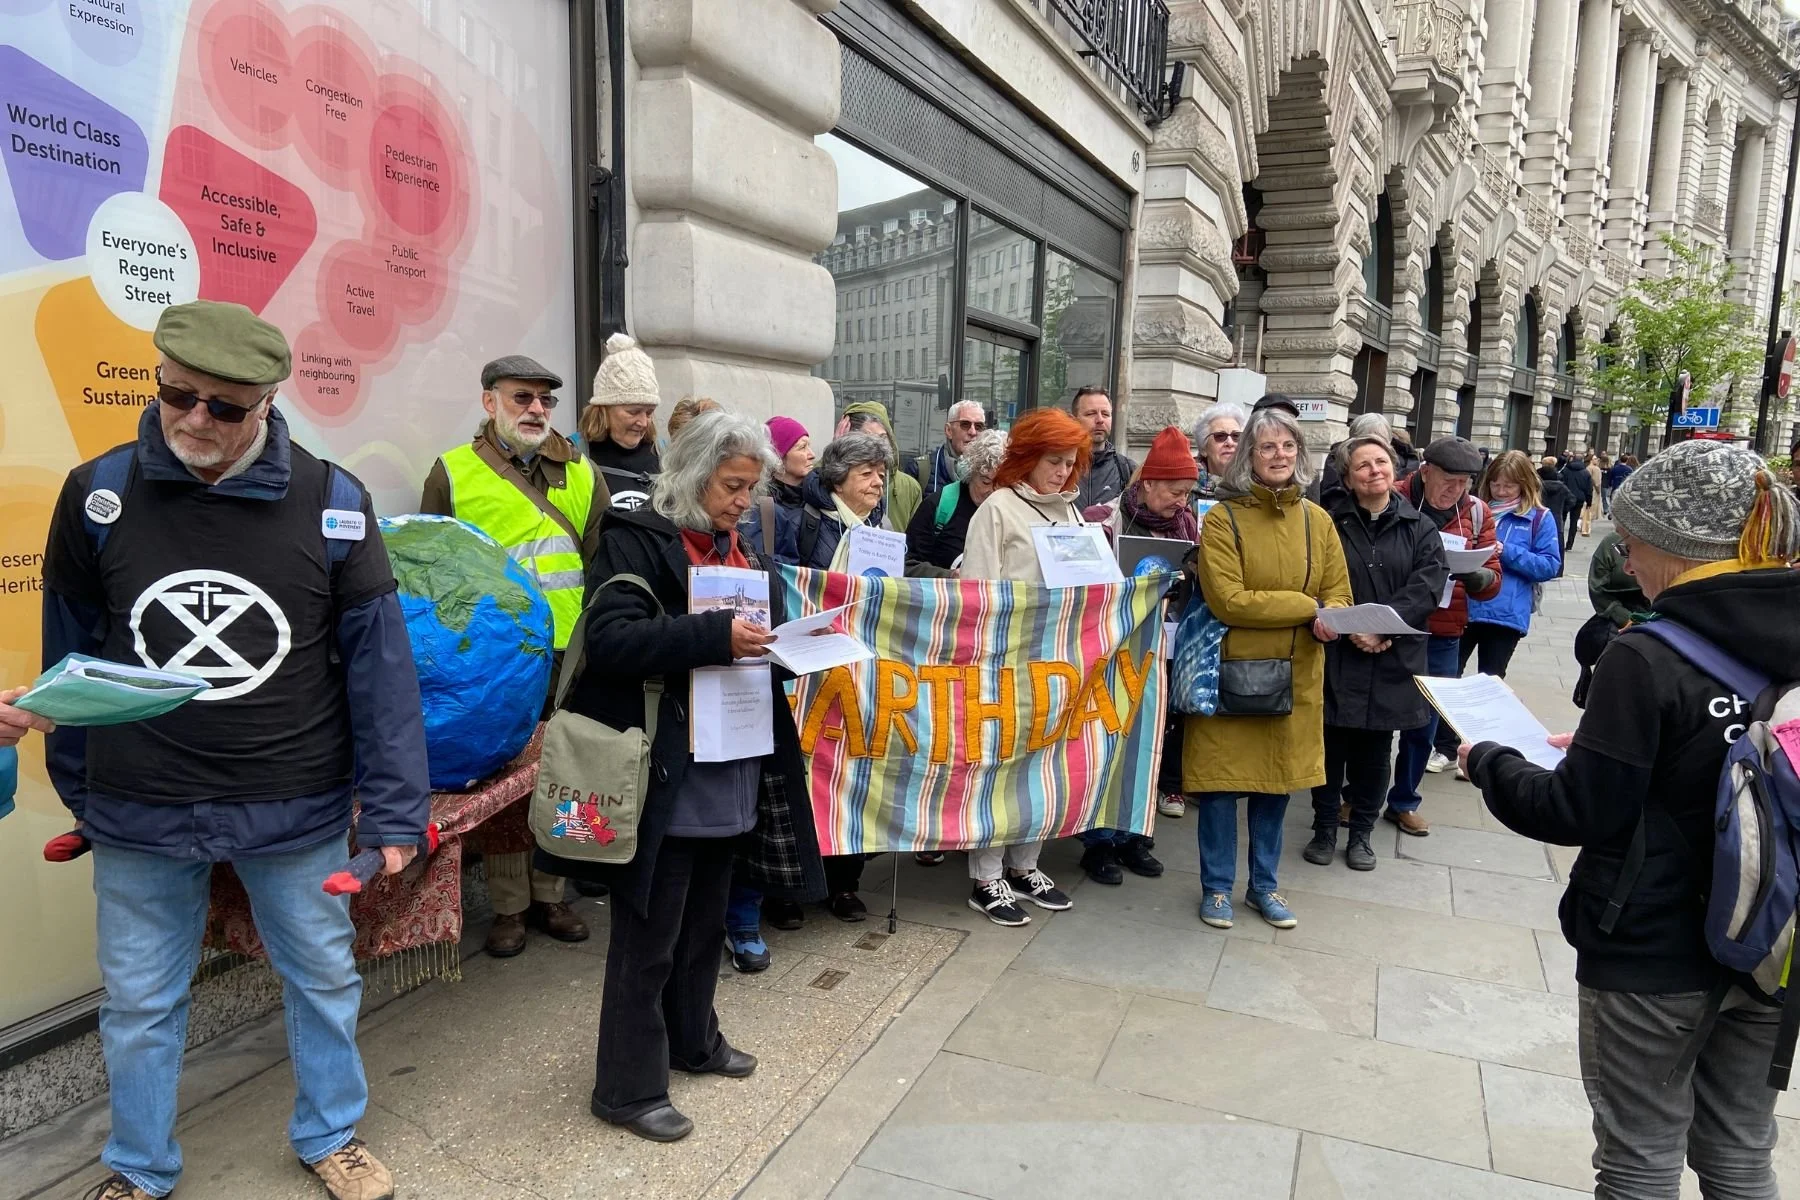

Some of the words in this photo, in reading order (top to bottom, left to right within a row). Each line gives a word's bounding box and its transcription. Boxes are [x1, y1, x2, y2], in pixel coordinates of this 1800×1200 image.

[83, 0, 125, 15] tural
[70, 4, 134, 36] Expression
[230, 57, 278, 84] Vehicles
[305, 79, 363, 108] Congestion
[325, 104, 347, 122] Free
[7, 103, 67, 134] World
[73, 120, 121, 148] Class
[11, 134, 121, 175] Destination
[385, 144, 438, 173] Pedestrian
[385, 165, 440, 192] Experience
[201, 185, 281, 218] Accessible,
[220, 214, 252, 234] Safe
[255, 221, 266, 237] &
[102, 231, 187, 260] Everyone's
[212, 237, 277, 263] Inclusive
[391, 244, 419, 260] Public
[119, 259, 175, 282] Regent
[385, 260, 426, 278] Transport
[125, 284, 172, 306] Street
[346, 284, 375, 299] Active
[346, 301, 375, 316] Travel
[96, 361, 149, 381] Green
[301, 352, 332, 367] Linking
[334, 355, 352, 367] with
[299, 368, 355, 384] neighbouring
[82, 387, 160, 407] Sustaina
[317, 386, 340, 395] areas
[1311, 403, 1324, 411] W1
[788, 659, 1017, 765] ARTH
[547, 783, 624, 807] BERLIN
